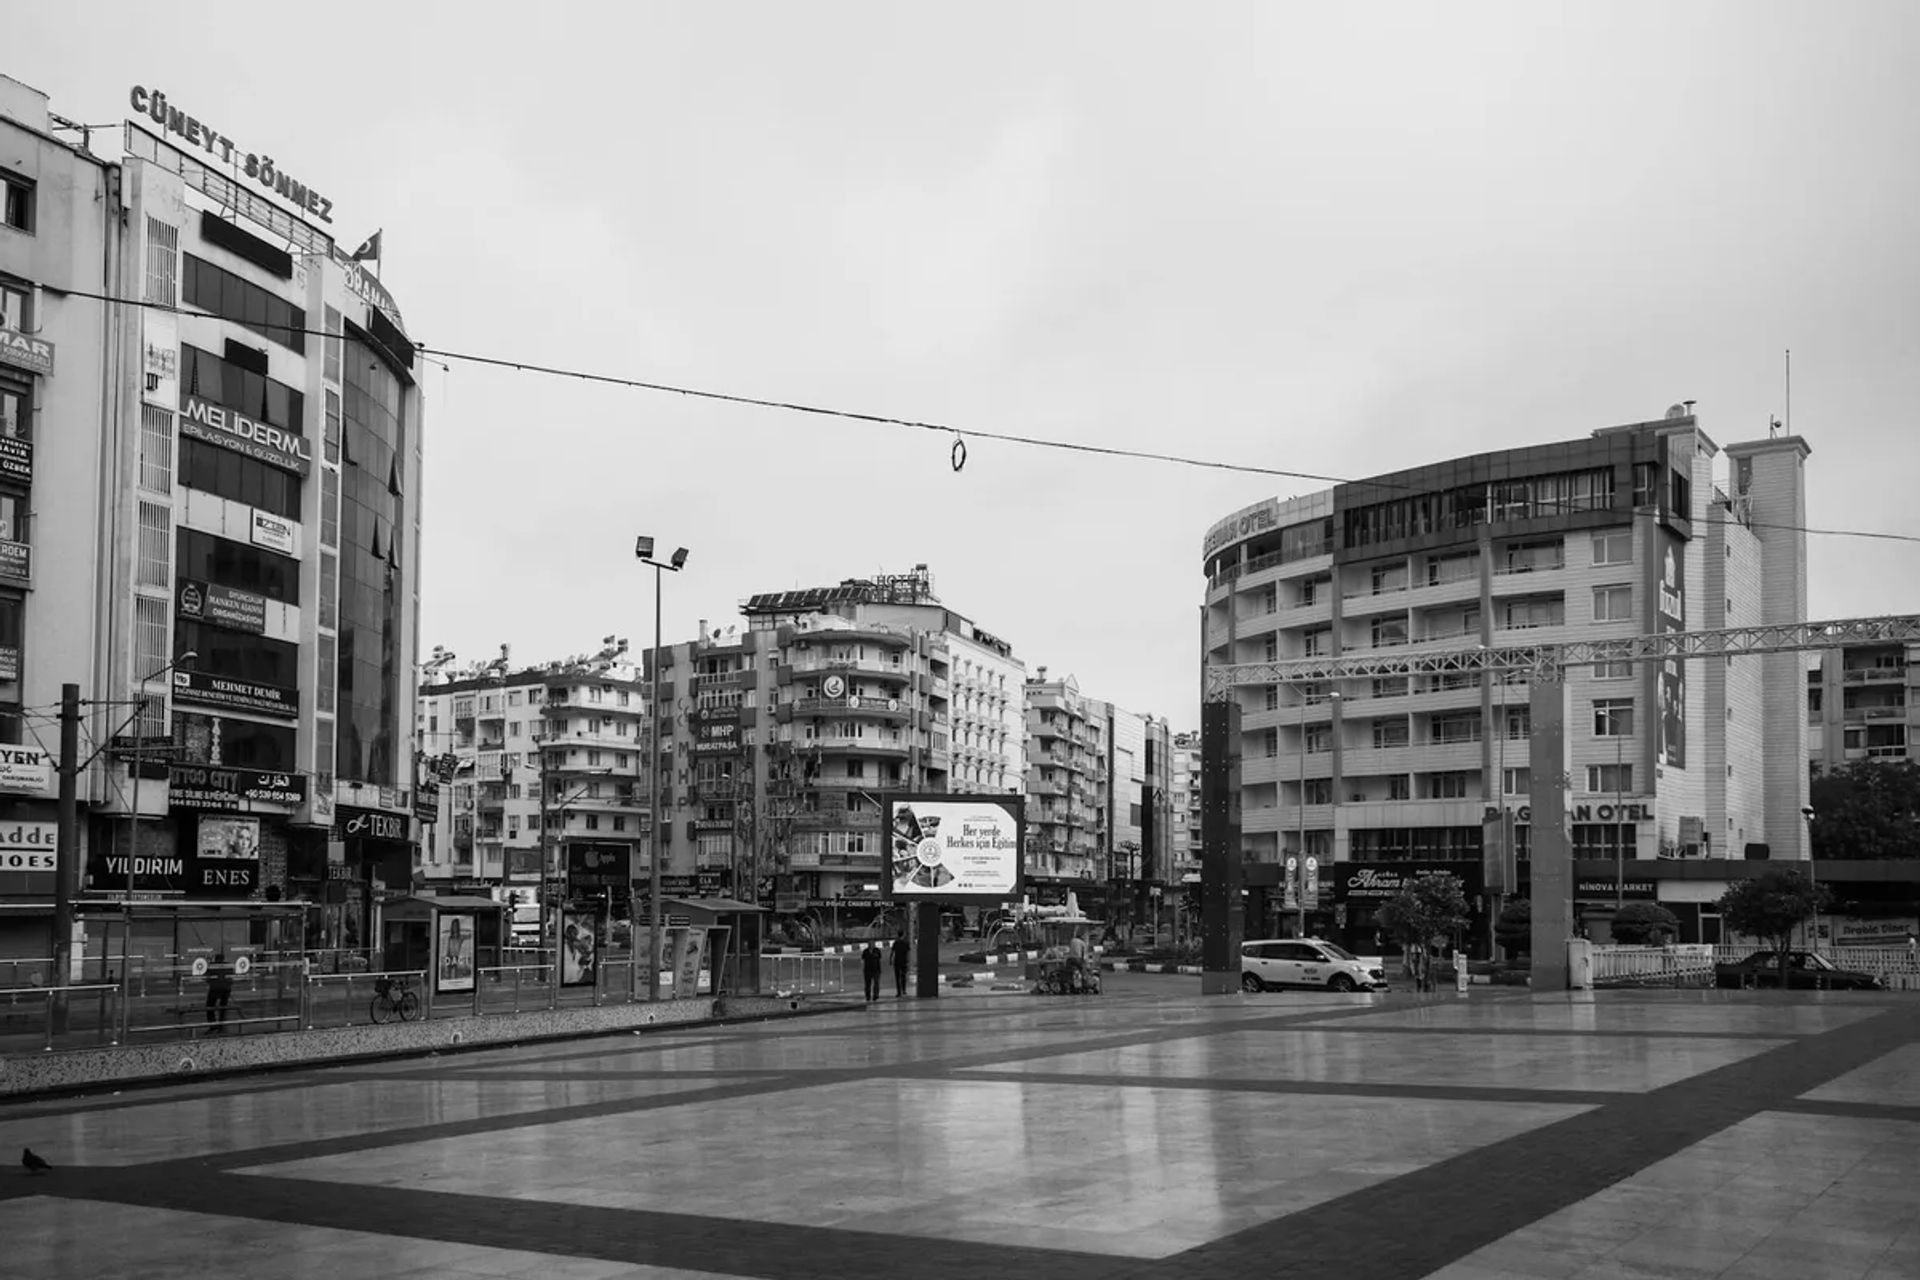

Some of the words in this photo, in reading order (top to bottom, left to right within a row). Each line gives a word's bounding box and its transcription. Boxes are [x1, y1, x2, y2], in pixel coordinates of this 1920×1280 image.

[130, 85, 235, 163] CÜNEYT
[245, 153, 333, 224] SÖNMEZ
[212, 680, 252, 695] MEHMET
[254, 687, 281, 700] DEMİR
[711, 724, 735, 738] MHP
[1597, 803, 1655, 821] OTEL
[963, 824, 977, 836] Her
[979, 825, 1001, 838] yerde
[947, 836, 974, 848] Herkes
[976, 836, 991, 850] için
[106, 857, 183, 875] YILDIRIM
[203, 869, 250, 885] ENES
[1579, 881, 1614, 892] NİNOVA
[1843, 925, 1879, 935] Arabic
